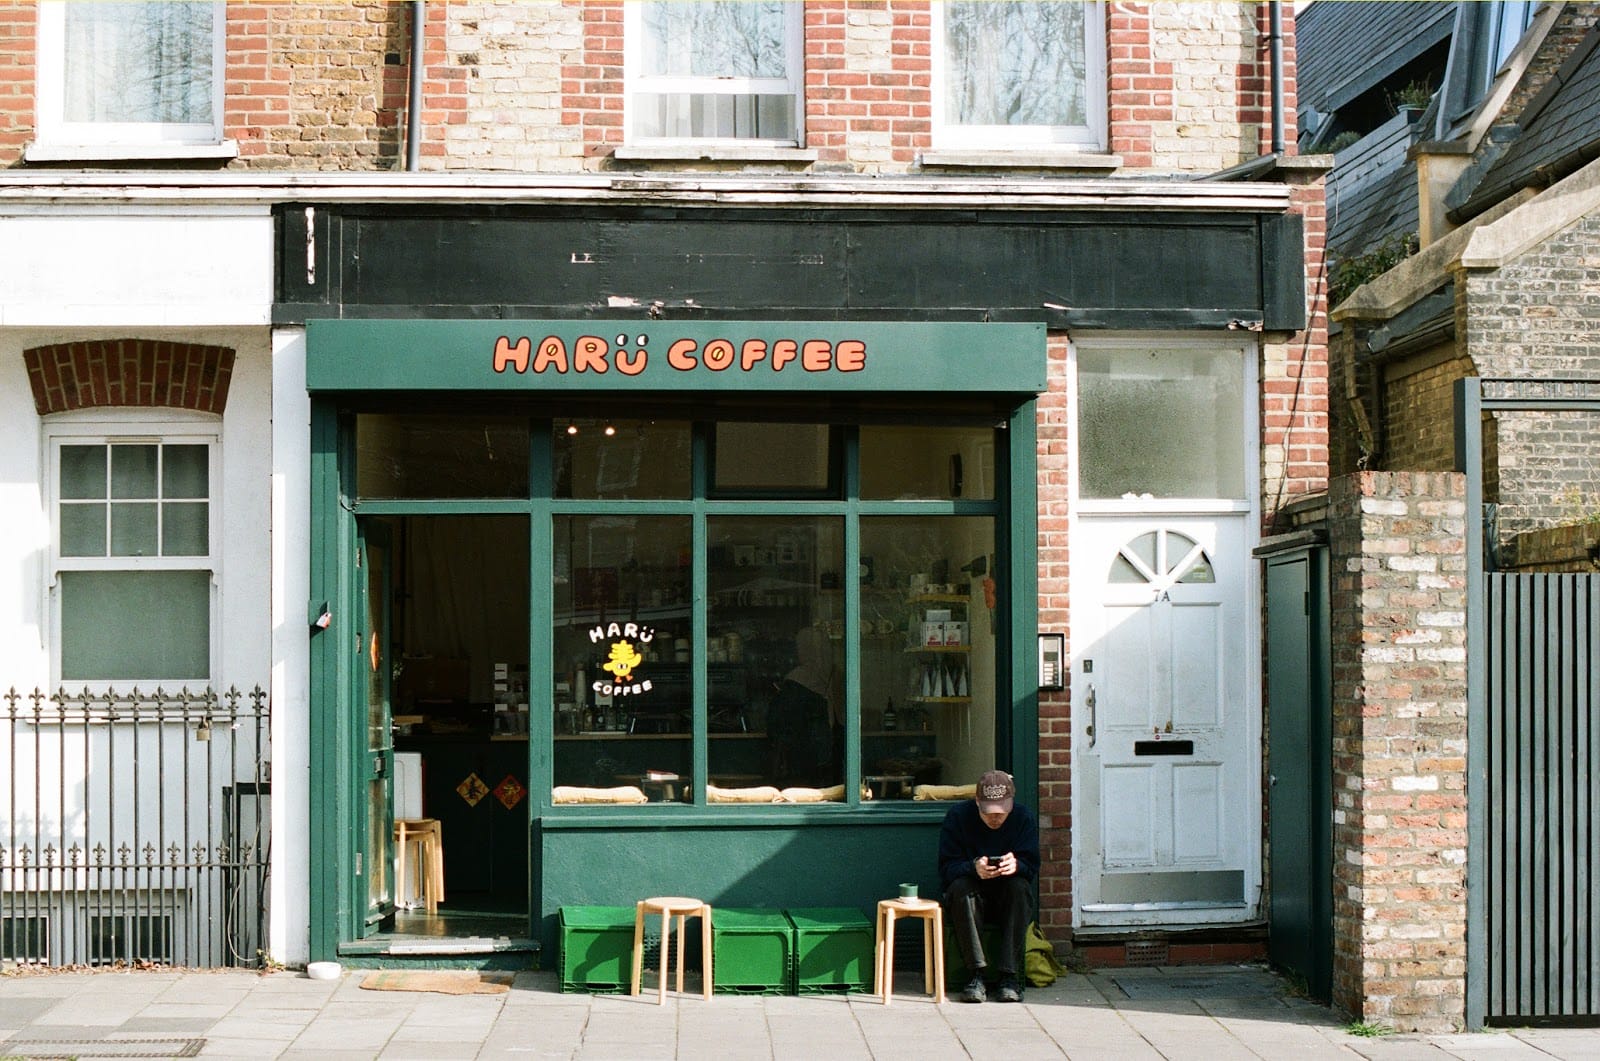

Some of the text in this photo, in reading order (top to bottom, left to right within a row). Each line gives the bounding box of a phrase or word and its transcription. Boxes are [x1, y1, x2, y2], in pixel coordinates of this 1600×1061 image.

[493, 333, 866, 376] HARÜ COFFEE
[1152, 588, 1171, 602] 7A
[589, 622, 655, 643] HARÜ
[592, 680, 653, 697] COFFEE
